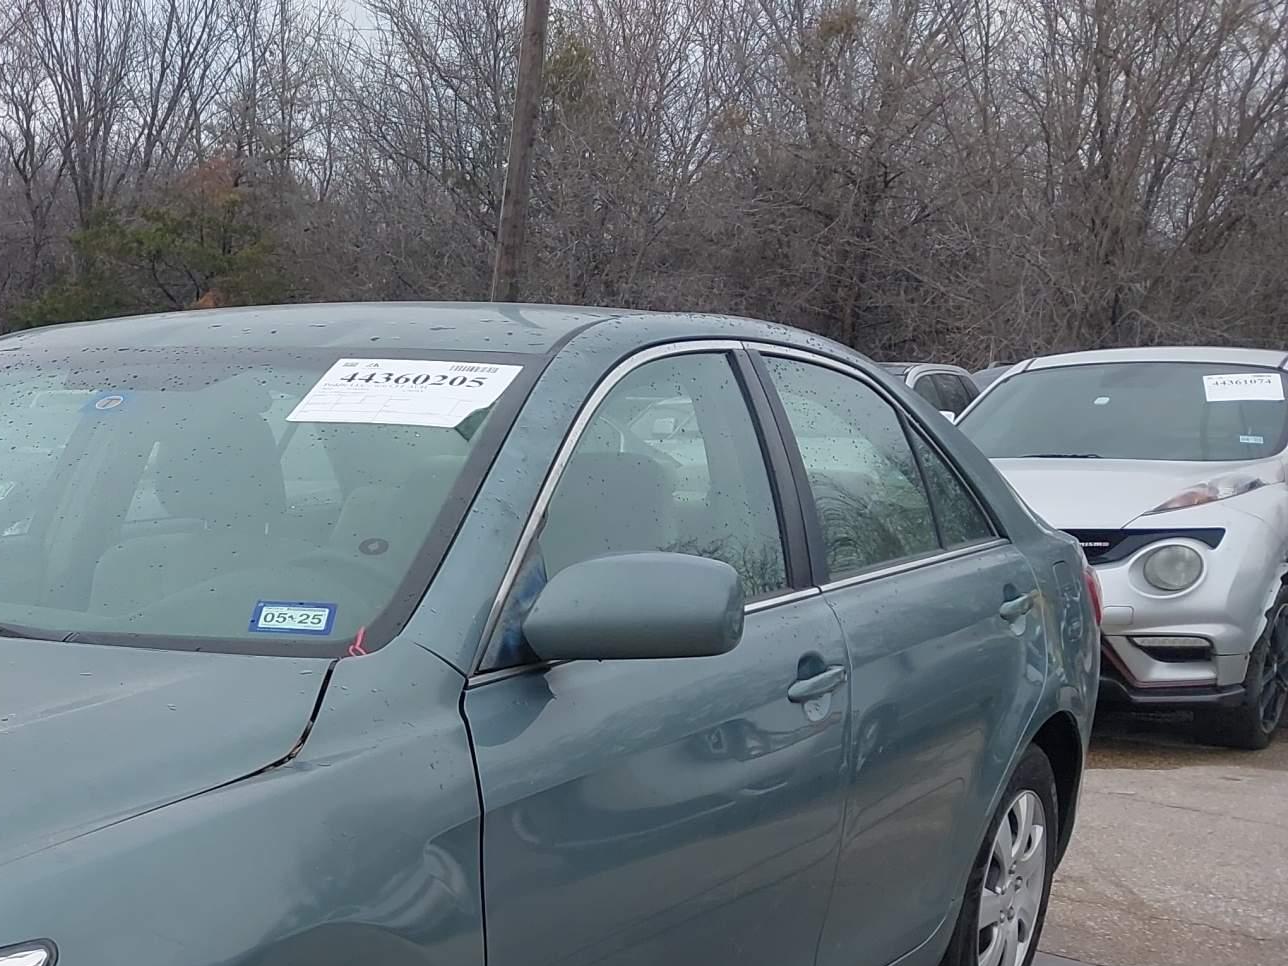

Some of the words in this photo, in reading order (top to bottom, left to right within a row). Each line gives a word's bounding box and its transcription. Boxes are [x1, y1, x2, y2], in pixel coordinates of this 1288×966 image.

[339, 371, 489, 389] 44360205
[263, 612, 289, 624] 05
[297, 613, 324, 625] 25
